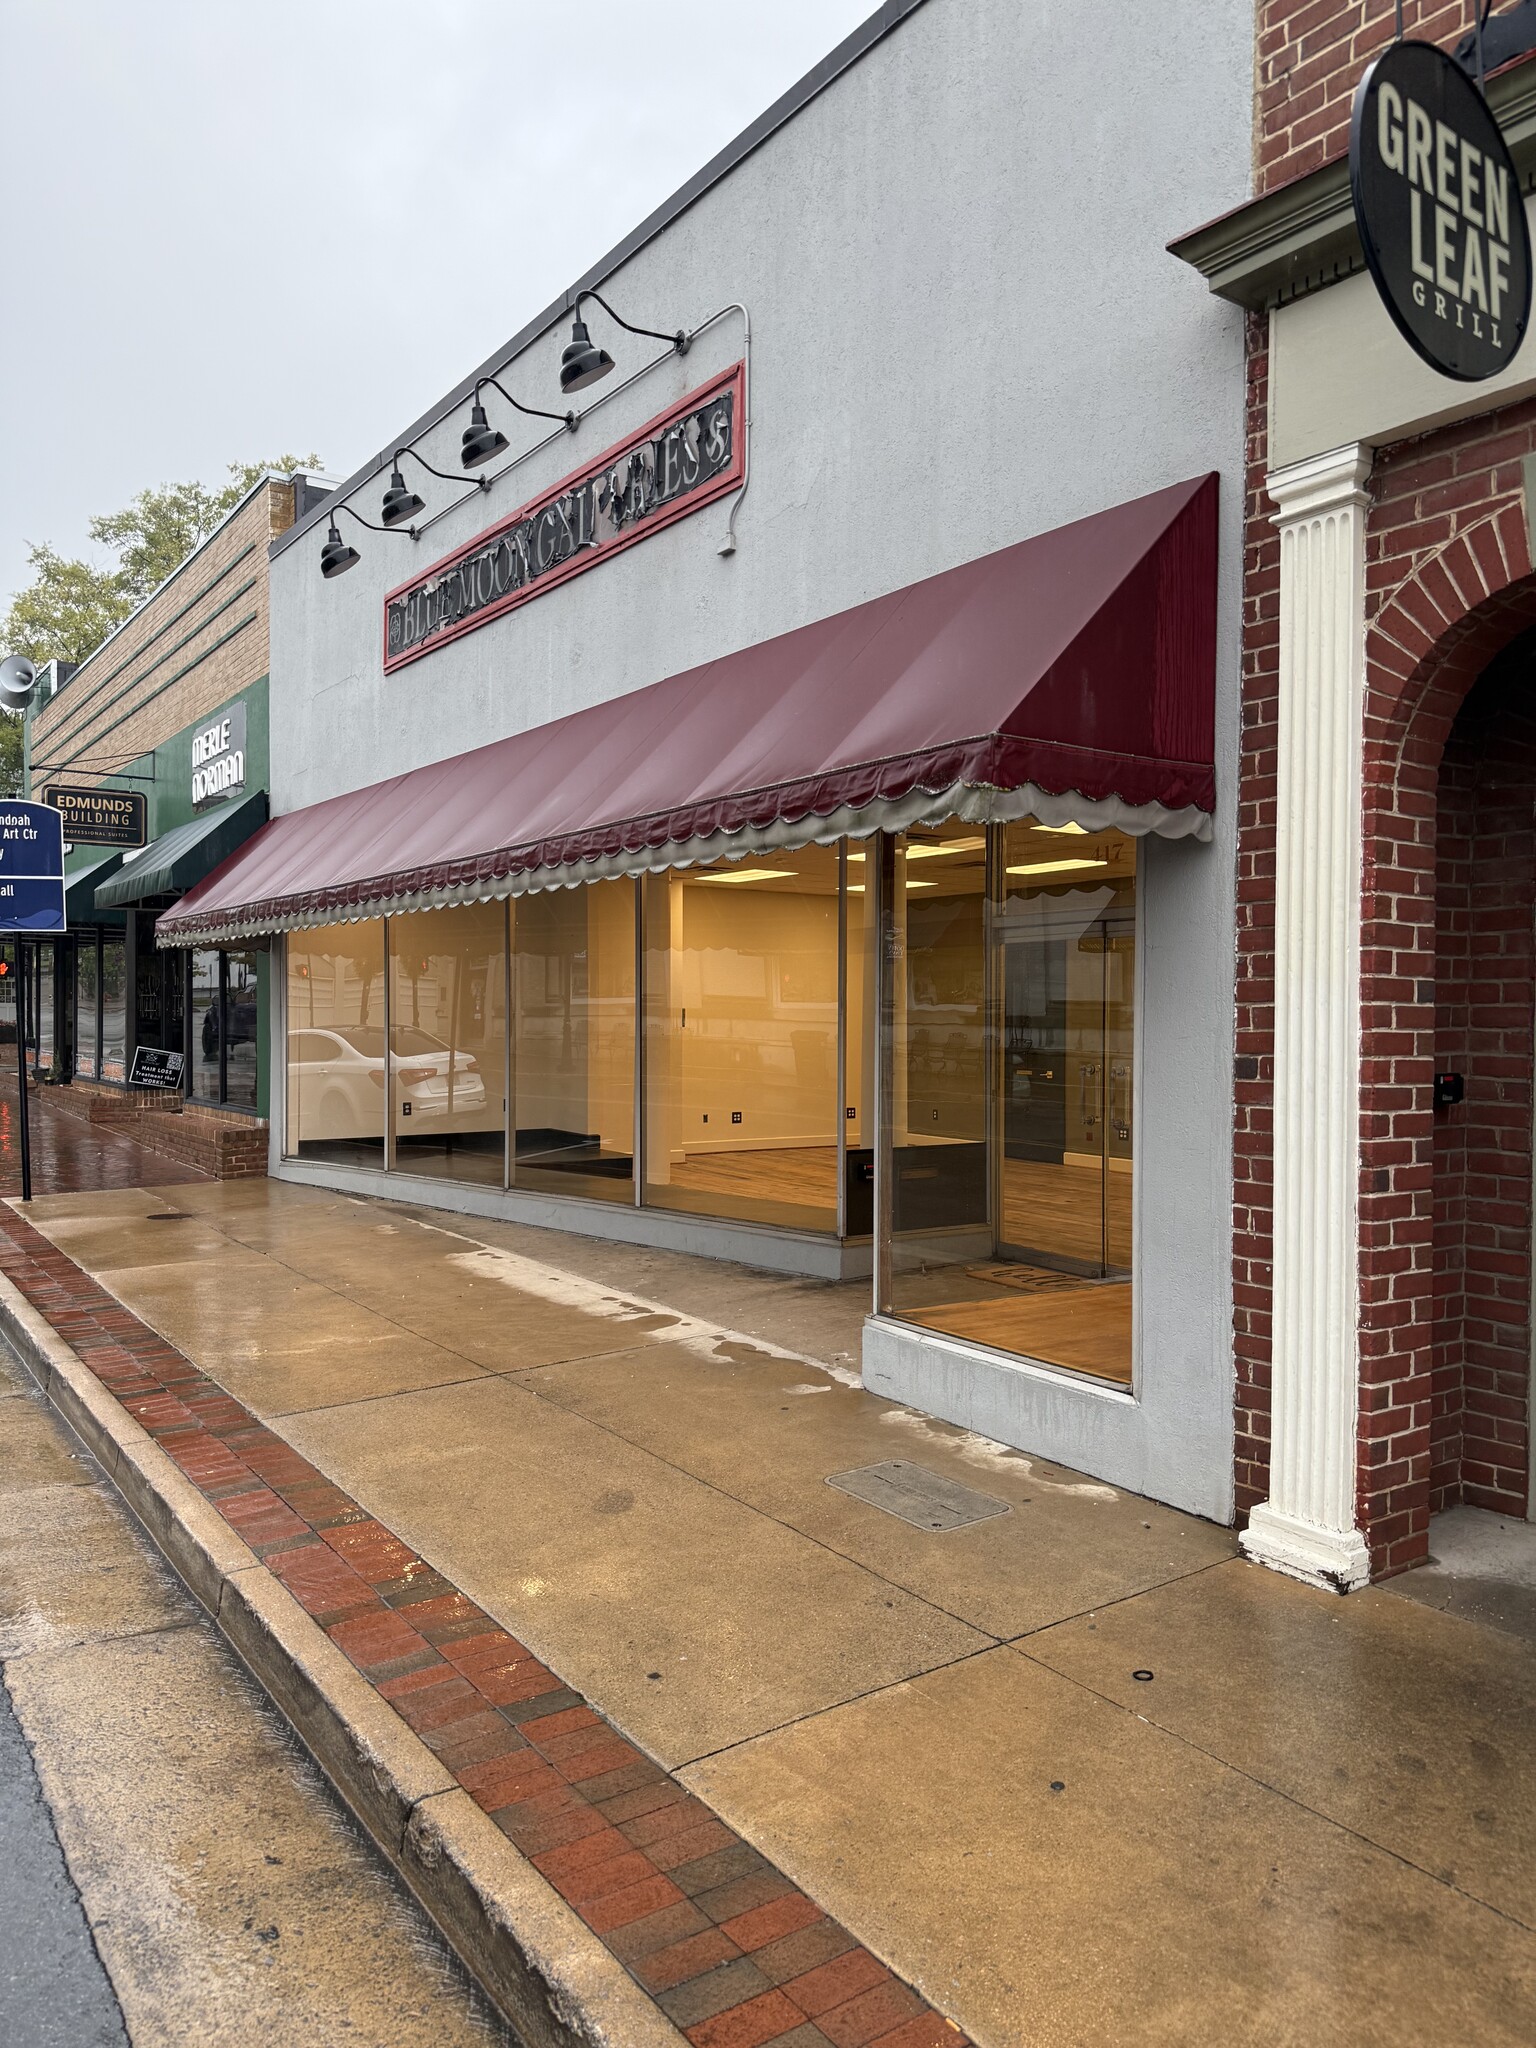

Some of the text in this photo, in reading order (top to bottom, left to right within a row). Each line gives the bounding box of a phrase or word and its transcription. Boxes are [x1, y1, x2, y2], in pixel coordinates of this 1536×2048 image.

[1377, 81, 1510, 245] GREEN
[1410, 188, 1511, 321] LEAF
[1412, 281, 1502, 349] GRILL
[192, 718, 231, 768] MERLE
[192, 750, 244, 804] NORMAN
[56, 795, 133, 813] EDMUNDS
[62, 810, 130, 826] BUILDING
[3, 828, 38, 840] Art Ctr
[1090, 843, 1124, 861] 417
